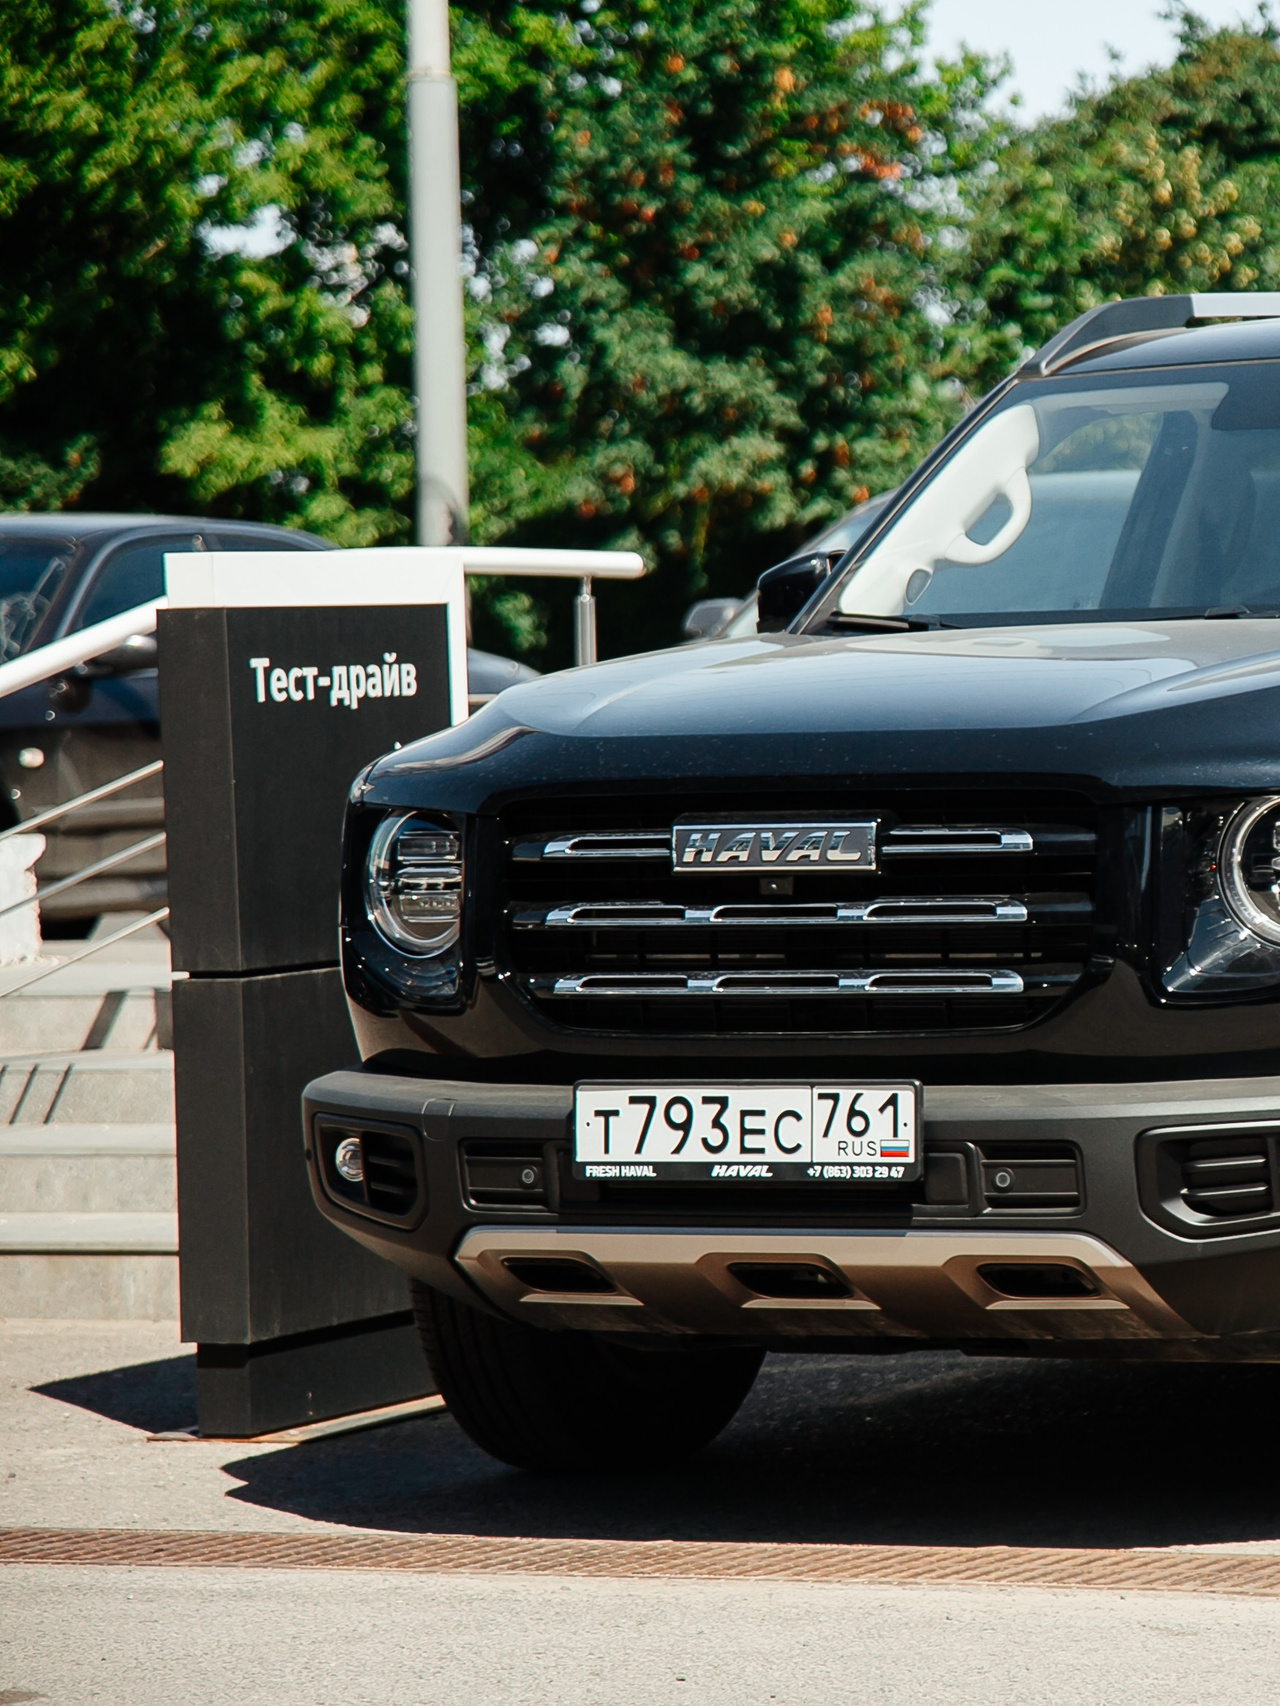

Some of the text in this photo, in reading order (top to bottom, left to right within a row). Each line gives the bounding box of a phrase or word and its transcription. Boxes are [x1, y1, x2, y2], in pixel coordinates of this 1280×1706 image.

[249, 652, 418, 709] Тест-драйв
[682, 831, 862, 863] HAVAL
[817, 1092, 900, 1138] 761
[838, 1140, 877, 1156] RUS
[585, 1165, 657, 1178] FRESH HAVAL
[711, 1165, 774, 1178] HAVAL
[807, 1165, 905, 1179] +7 (863) 303 29 47
